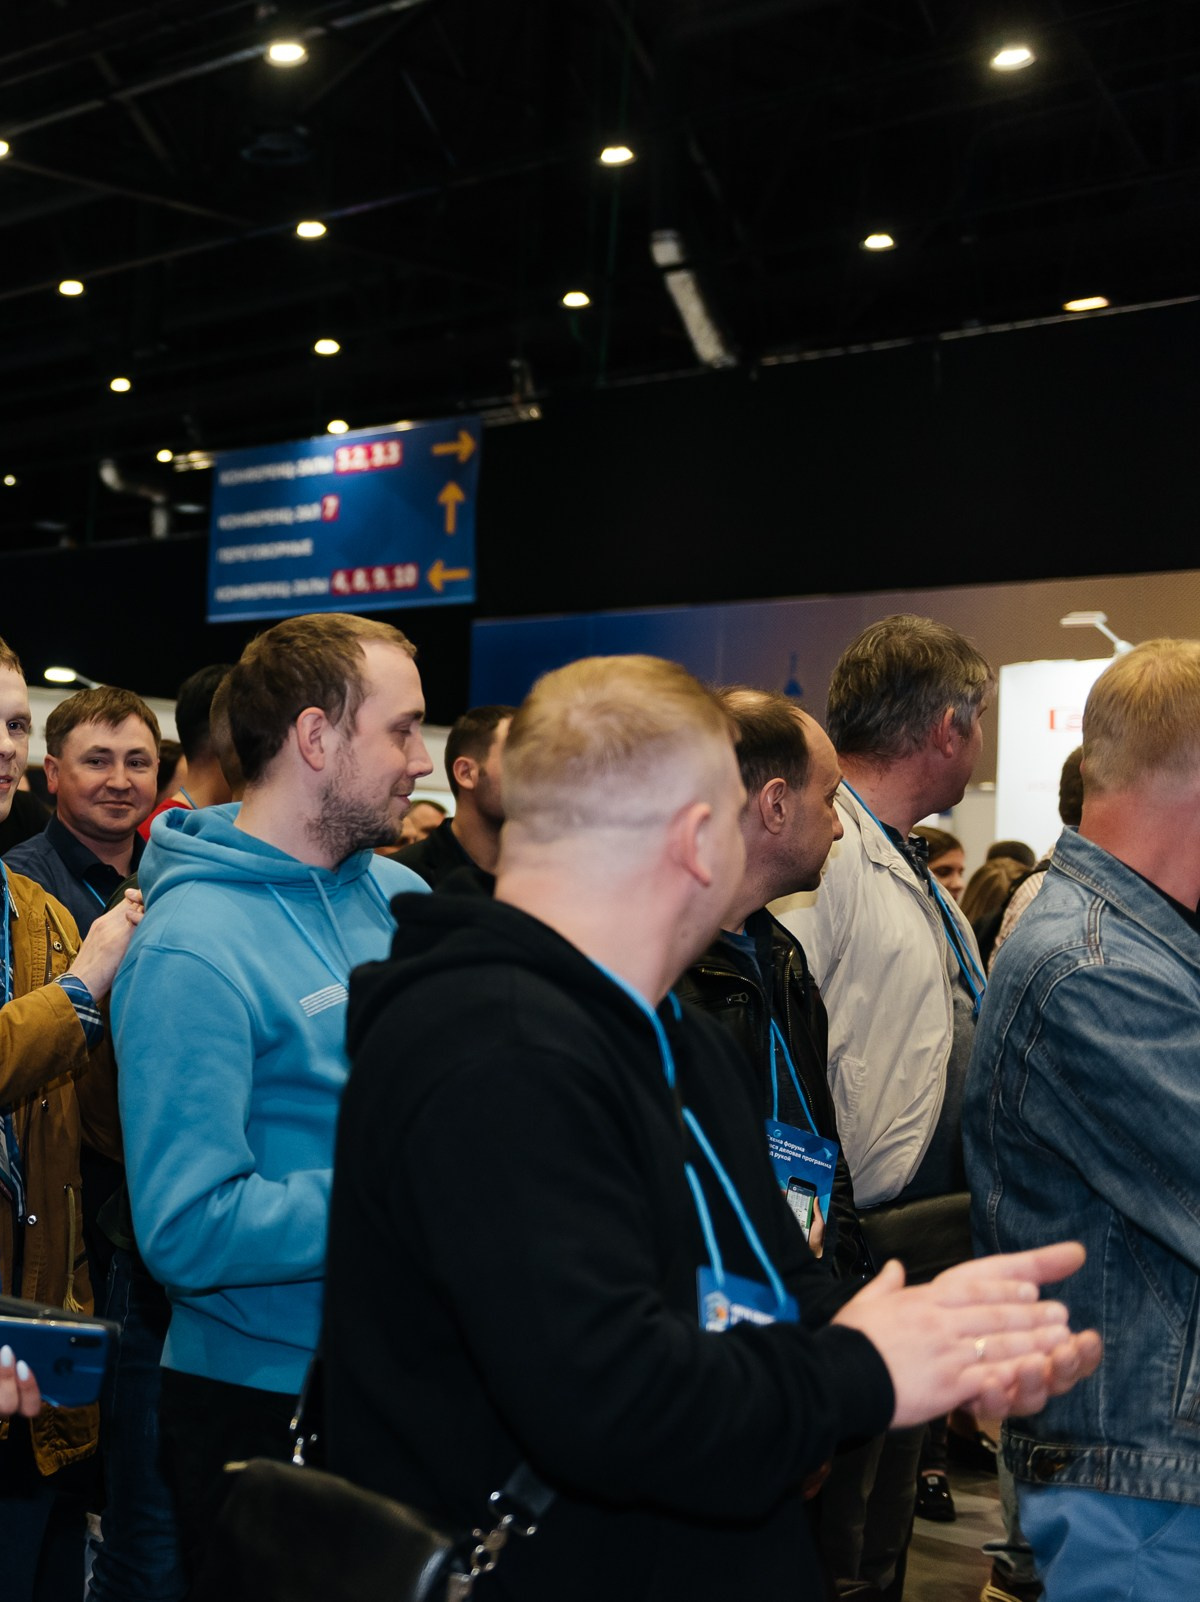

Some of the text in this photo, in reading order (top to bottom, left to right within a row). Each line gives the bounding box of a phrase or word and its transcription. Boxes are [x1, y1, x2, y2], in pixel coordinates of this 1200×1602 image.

[784, 1141, 805, 1152] форума
[774, 1153, 792, 1162] рукой
[779, 1148, 801, 1158] деловая
[802, 1155, 832, 1169] программа
